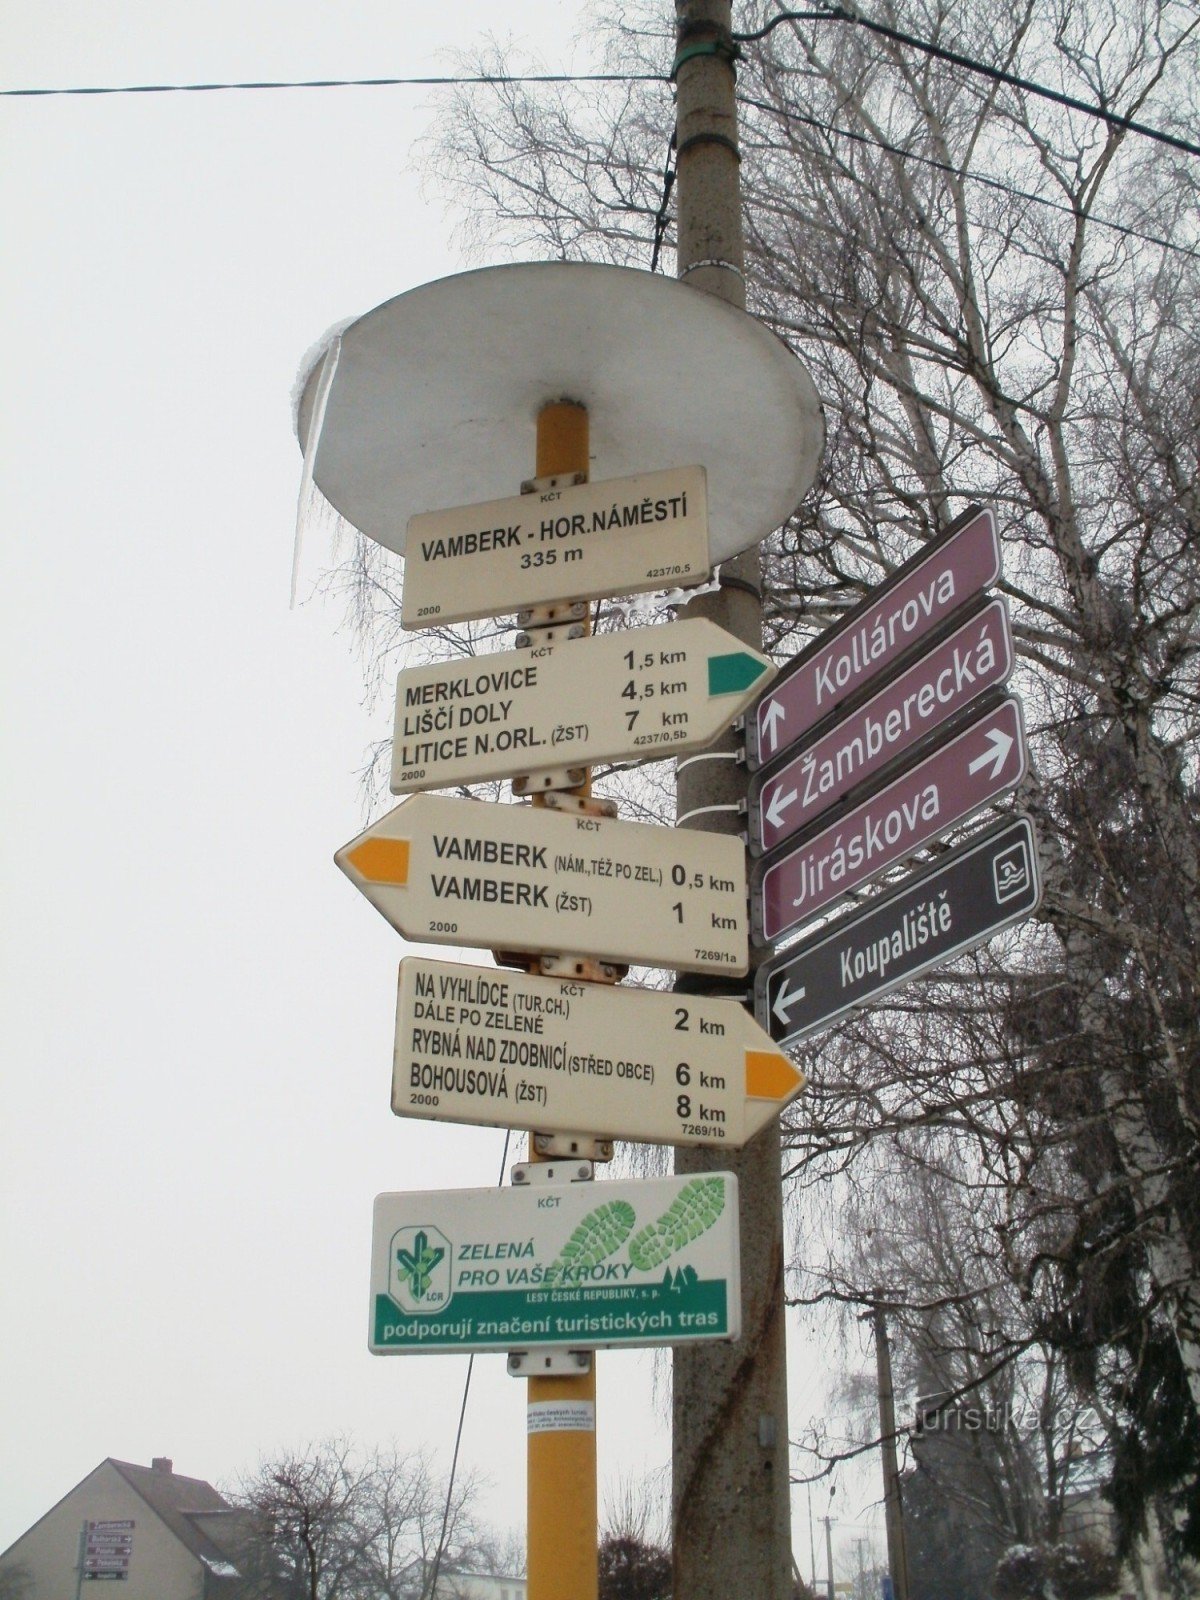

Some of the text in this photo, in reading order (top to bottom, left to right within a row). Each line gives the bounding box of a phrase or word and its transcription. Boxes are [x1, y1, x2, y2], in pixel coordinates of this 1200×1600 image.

[540, 491, 562, 503] KČT
[421, 525, 522, 562] VAMBERK
[540, 491, 687, 541] HOR.NÁMĚSTÍ
[520, 547, 583, 570] 335 m
[417, 605, 441, 617] 2000
[813, 568, 957, 706] Kollárova
[530, 647, 554, 659] KČT
[405, 650, 686, 707] MERKLOVICE 1,5 km
[404, 680, 687, 737] LIŠČÍ DOLY 4,5 km
[801, 624, 997, 809] Žamberecká
[402, 710, 689, 767] LITICE N.ORL. (ŽST) 7 km
[401, 769, 426, 781] 2000
[576, 818, 602, 832] KČT
[792, 783, 940, 908] Jiráskova
[432, 835, 548, 869] VAMBERK
[615, 863, 632, 879] PO
[634, 866, 663, 887] ZEL.)
[671, 864, 704, 889] 0,5
[709, 875, 736, 892] km
[430, 874, 738, 930] VAMBERK (ŽST) 1 km
[429, 921, 458, 933] 2000
[839, 889, 953, 990] Koupaliště
[694, 949, 738, 963] 7269/1a
[415, 972, 726, 1036] NA VYHLÍDCE (TUR.CH.) 2 km
[560, 984, 586, 997] KČT
[414, 1001, 545, 1035] DÁLE PO ZELENÉ
[412, 1027, 726, 1090] RYBNÁ NAD ZDOBNICÍ (STŘED OBCE) 6 km
[410, 1062, 726, 1122] BOHOUSOVÁ (ŽST) 8 km
[410, 1093, 440, 1107] 2000
[681, 1123, 726, 1138] 7269/1b
[537, 1196, 562, 1209] KČT
[458, 1237, 535, 1261] ZELENÁ
[457, 1263, 634, 1287] PRO VAŠE KROKY
[526, 1292, 549, 1303] LESY
[551, 1288, 582, 1302] ČESKÉ
[583, 1288, 640, 1301] REPUBLIKY,
[383, 1309, 719, 1340] podporují značení turistických tras
